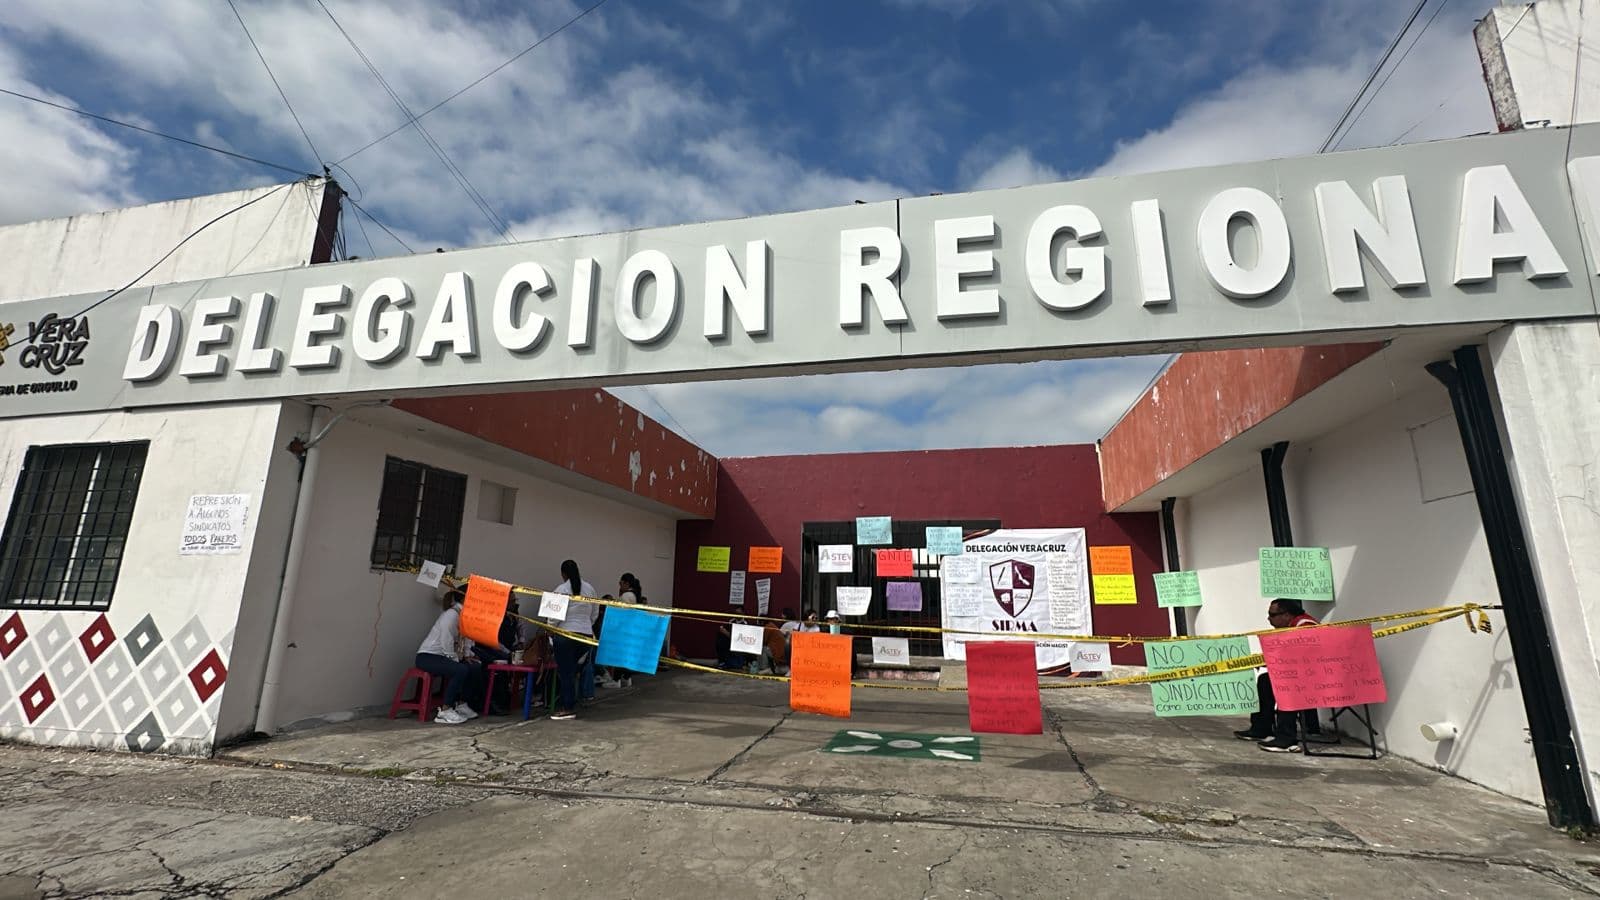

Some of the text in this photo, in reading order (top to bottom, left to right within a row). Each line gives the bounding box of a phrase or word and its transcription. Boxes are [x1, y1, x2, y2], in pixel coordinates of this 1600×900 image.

[123, 239, 769, 382] DELEGACION
[28, 313, 90, 344] VERA
[19, 341, 88, 375] CRUZ
[16, 384, 30, 394] DE
[30, 380, 77, 393] ORGULLO
[966, 542, 1067, 553] DELEGACIÓN VERACRUZ
[992, 620, 1038, 632] SIRMA
[1151, 645, 1185, 666] NO
[1196, 643, 1250, 664] SOMOS
